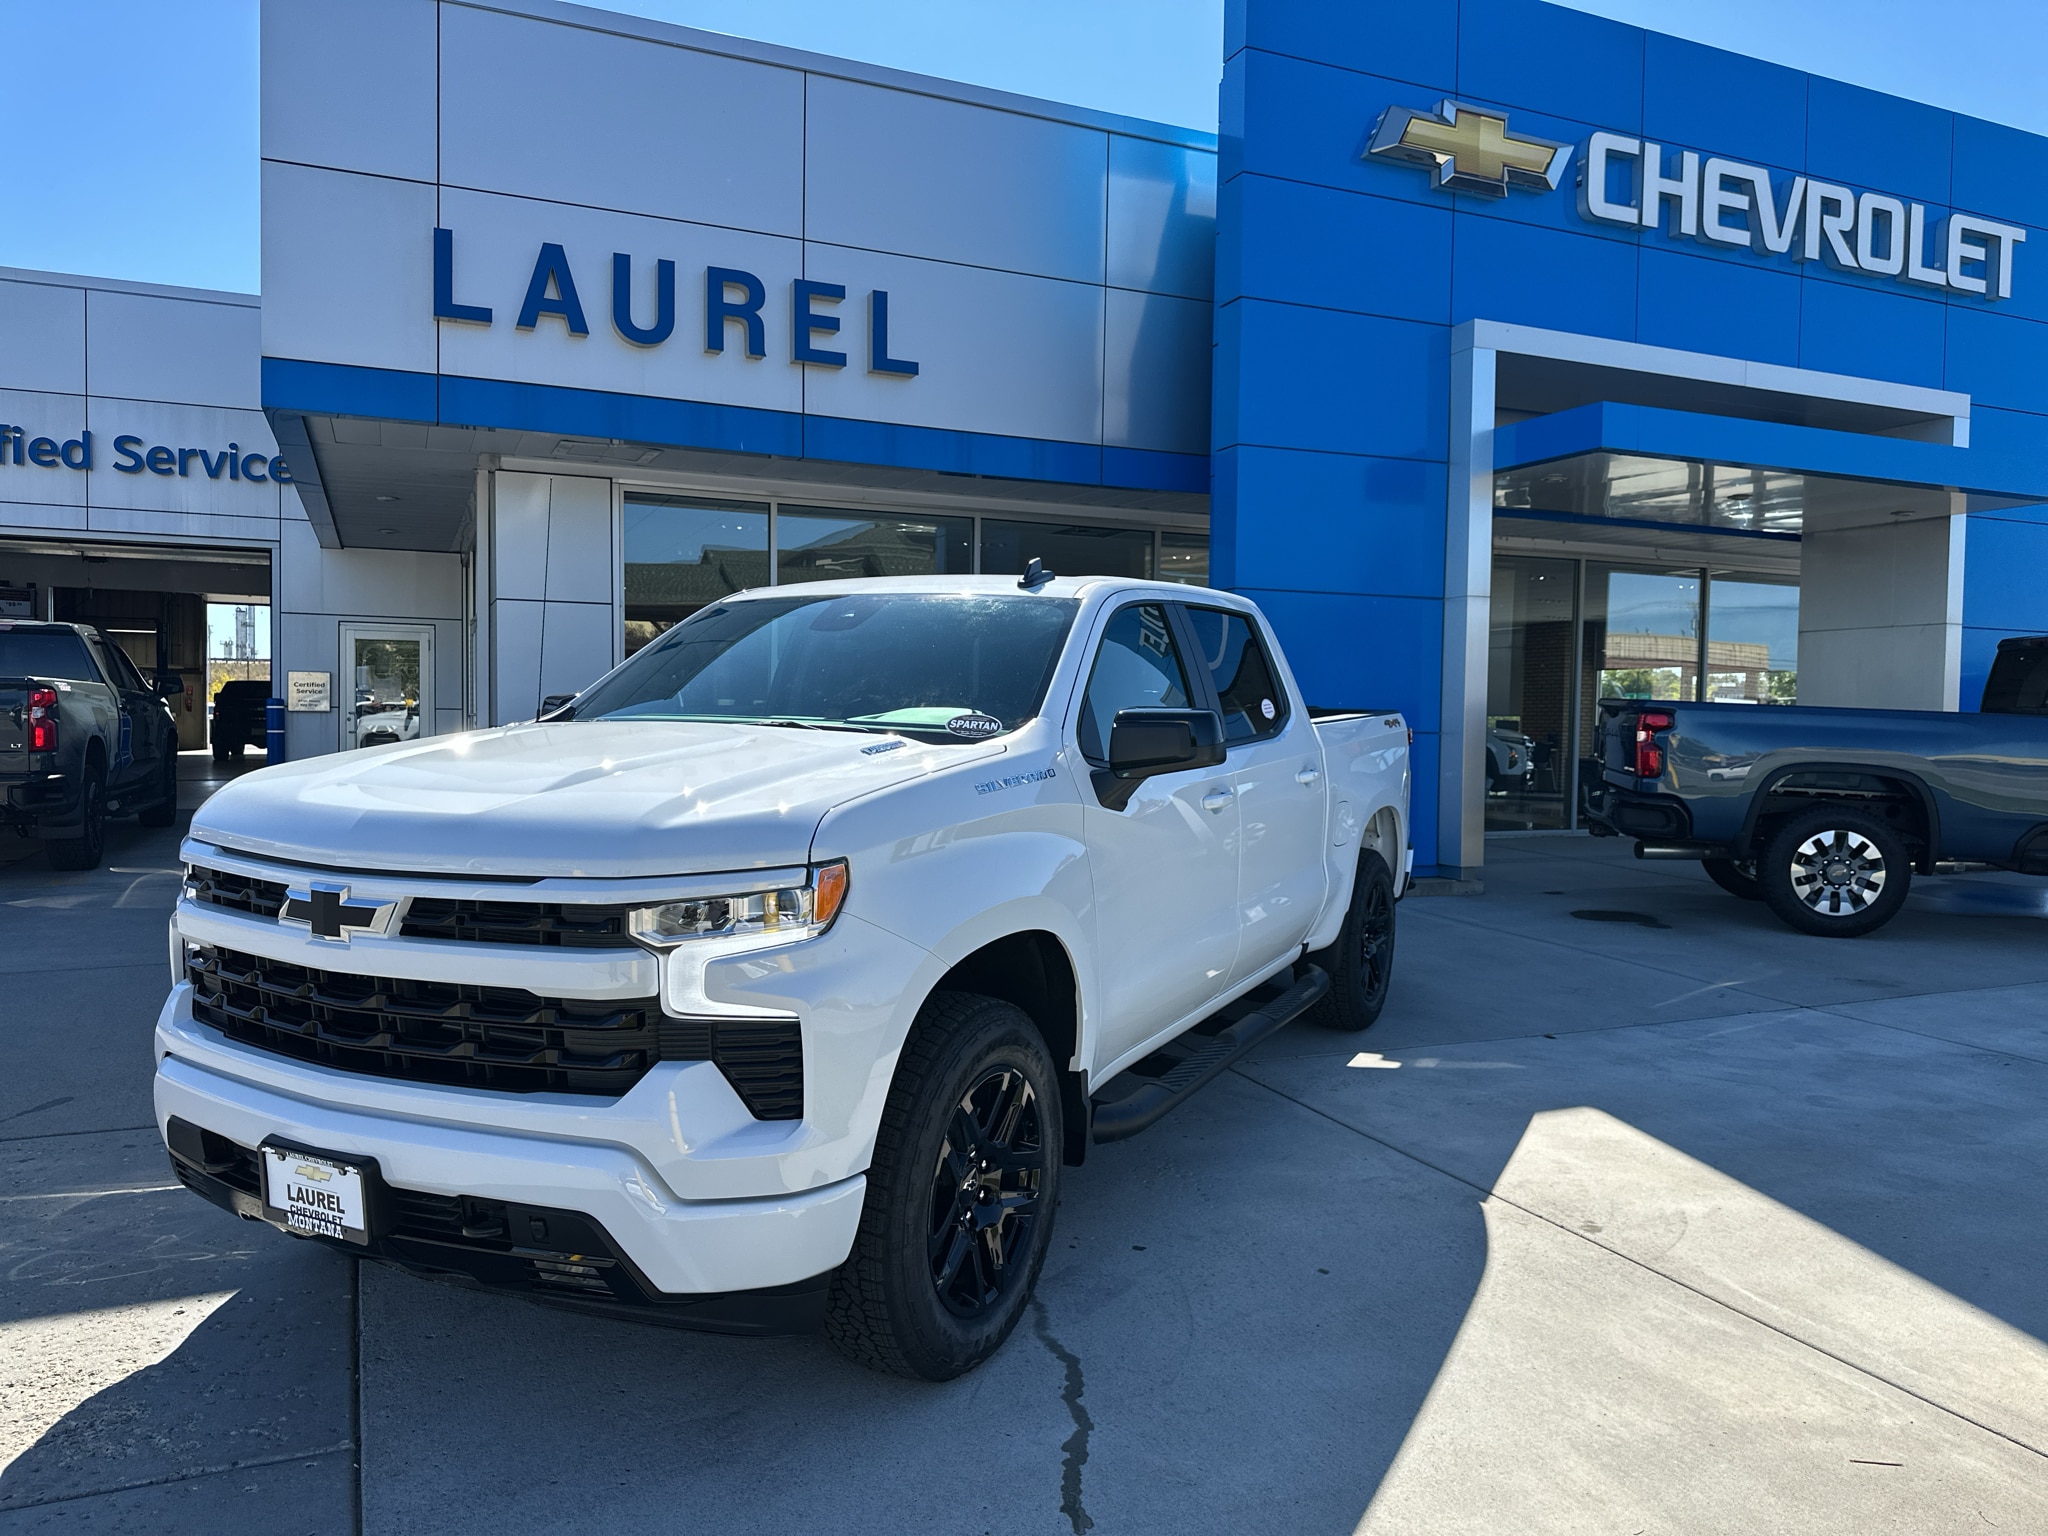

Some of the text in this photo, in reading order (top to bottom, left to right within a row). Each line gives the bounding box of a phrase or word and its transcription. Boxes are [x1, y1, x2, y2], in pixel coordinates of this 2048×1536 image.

[1583, 132, 2026, 300] CHEVROLET
[433, 227, 919, 377] LAUREL
[113, 434, 292, 484] Service
[949, 719, 999, 731] SPARTAN
[287, 1184, 346, 1215] LAUREL
[289, 1204, 344, 1226] CHEVROLET
[287, 1213, 344, 1239] MONTANA
